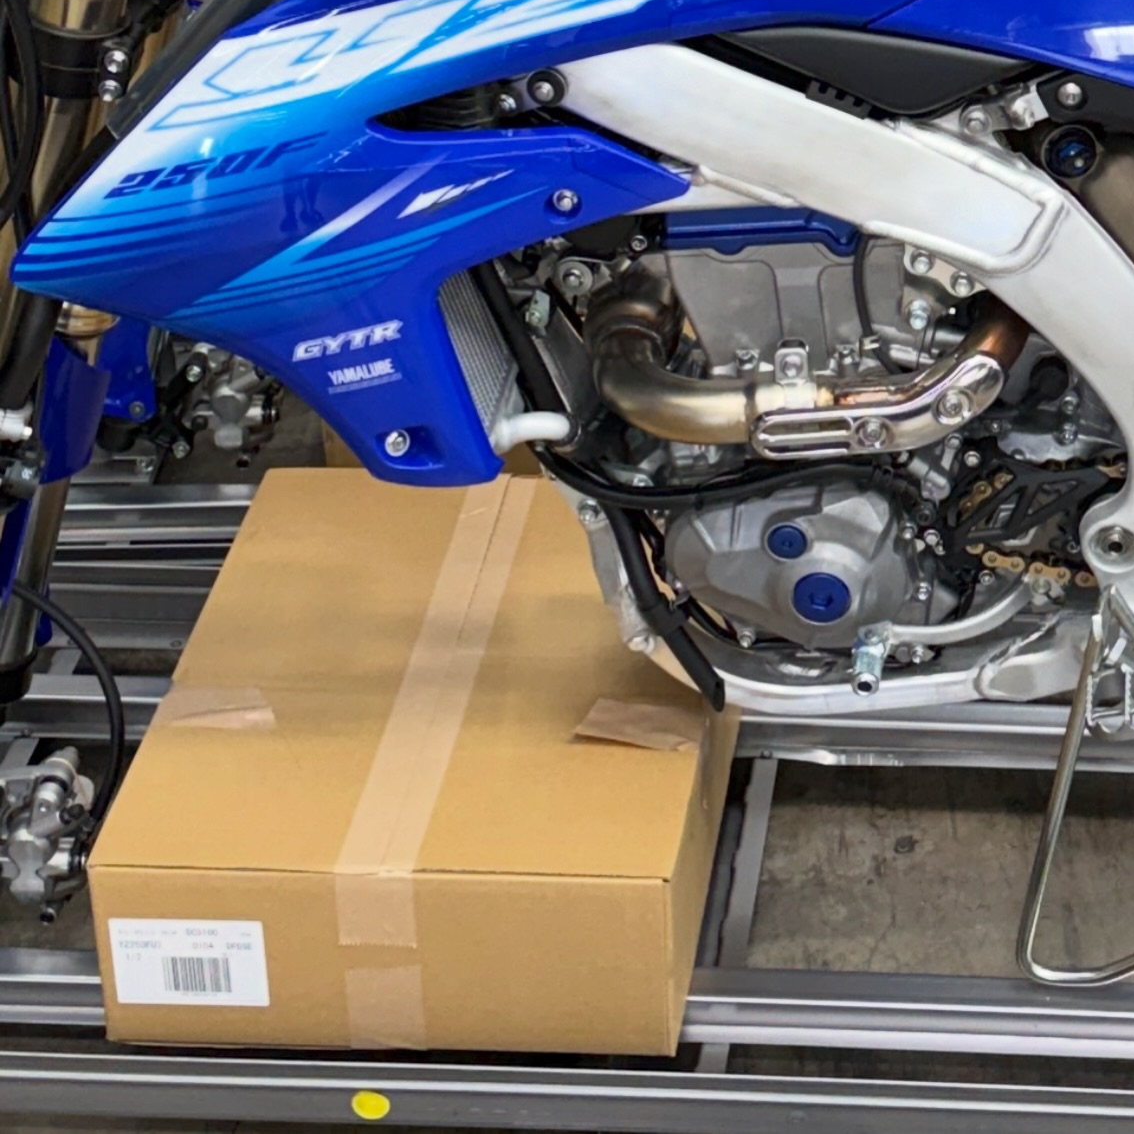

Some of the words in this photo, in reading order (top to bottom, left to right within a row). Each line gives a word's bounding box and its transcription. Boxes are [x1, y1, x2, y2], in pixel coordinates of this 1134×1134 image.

[103, 129, 330, 200] 250F
[292, 319, 404, 362] GYTR
[327, 358, 395, 386] YAMALUBE
